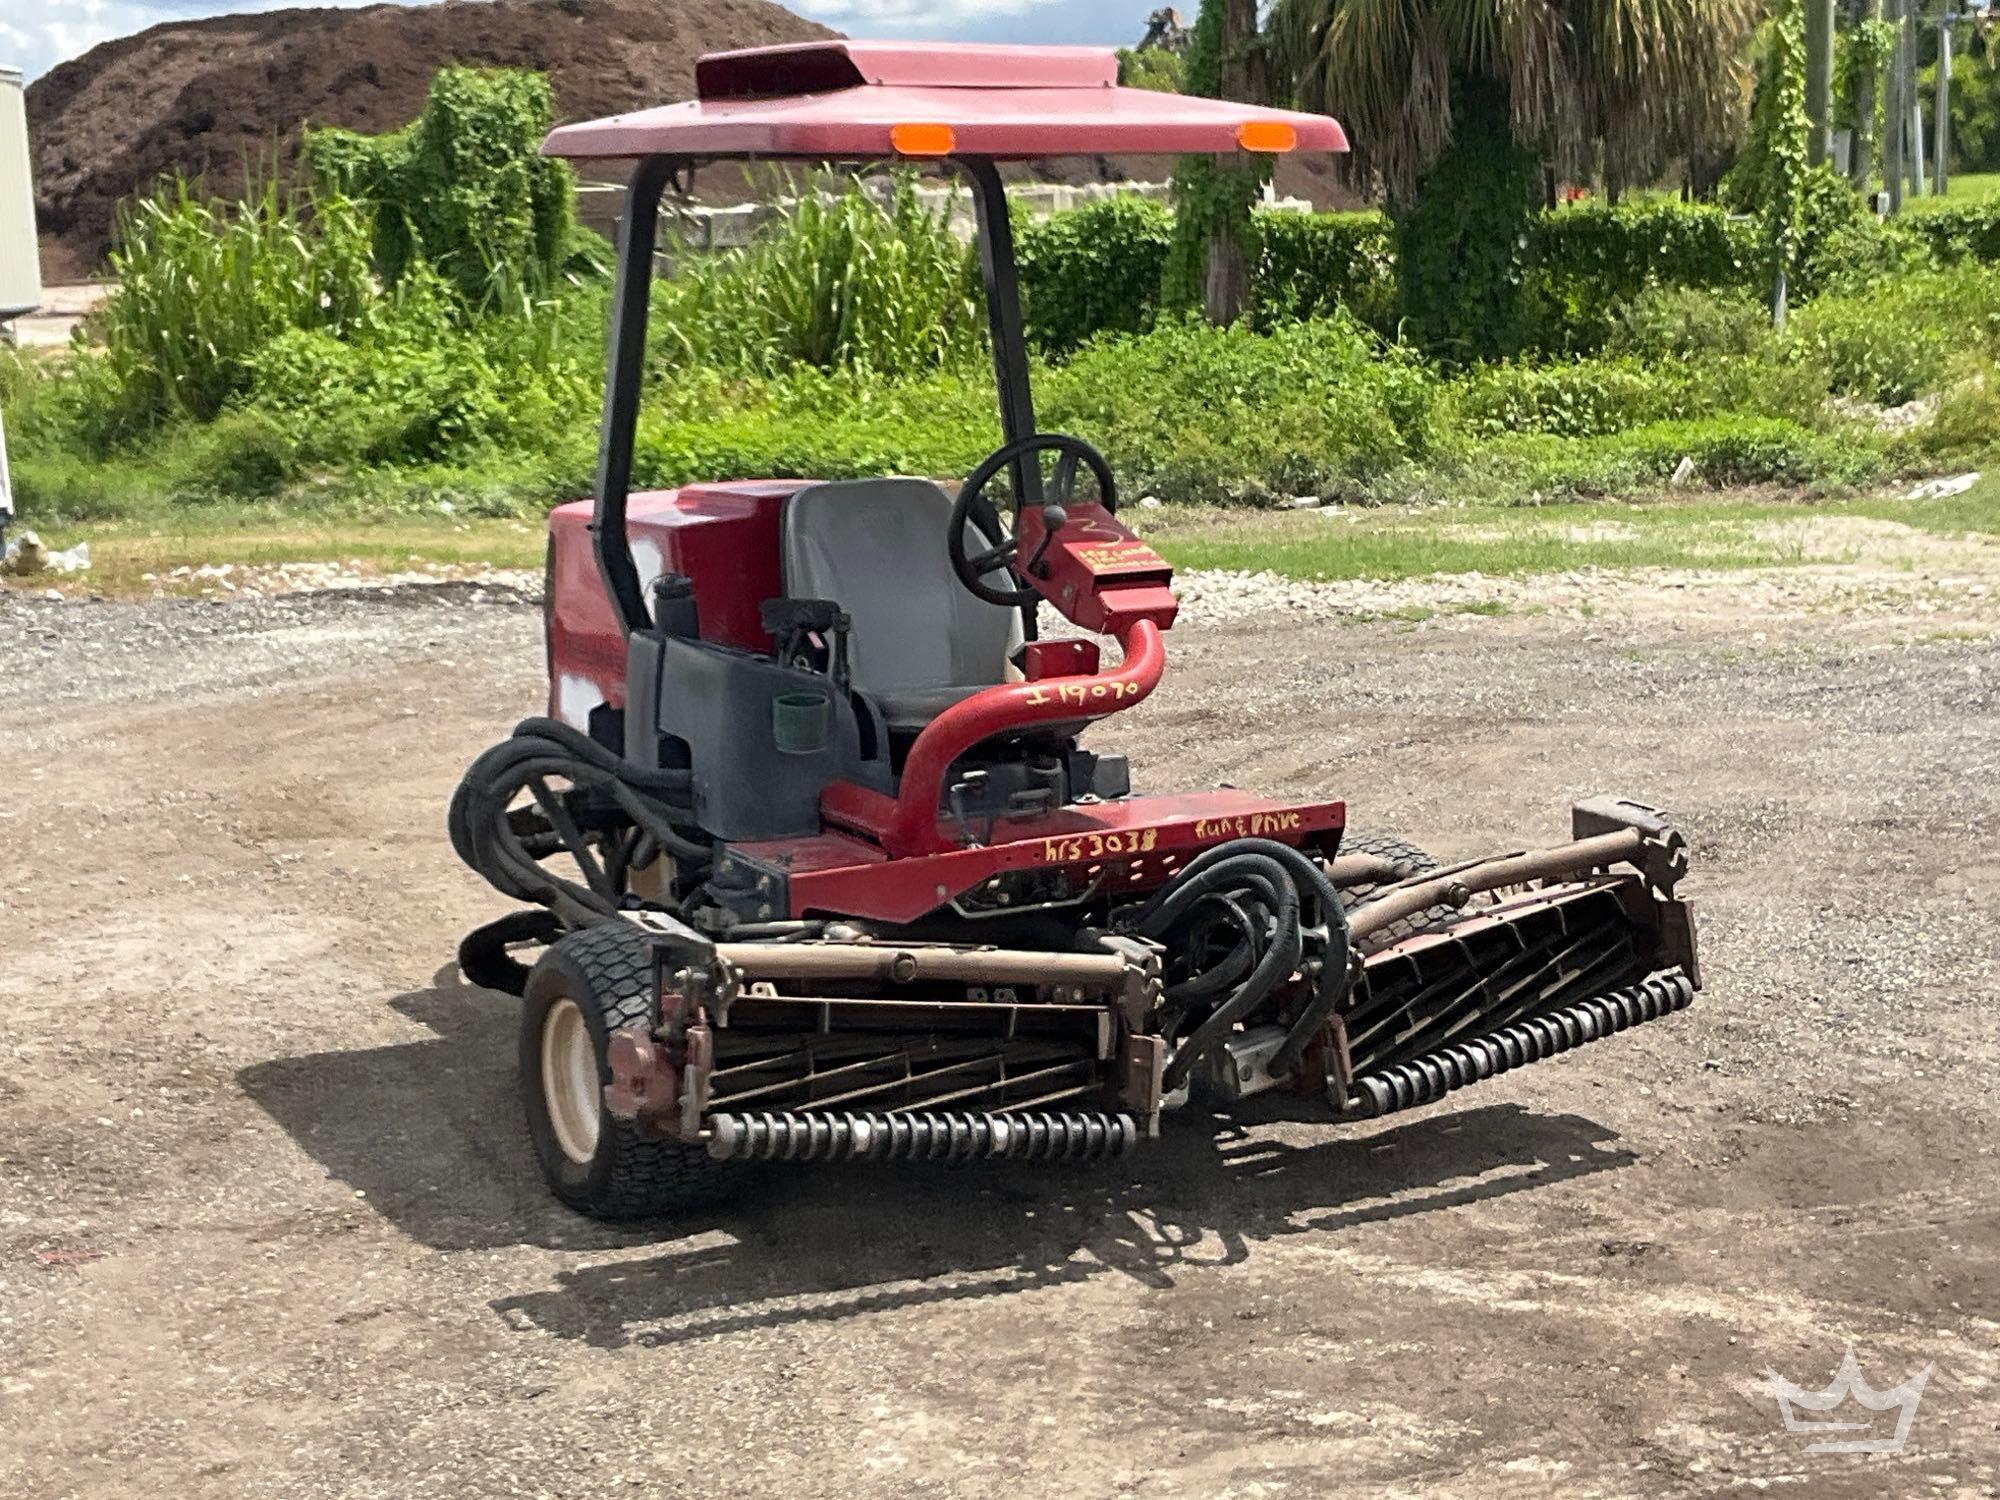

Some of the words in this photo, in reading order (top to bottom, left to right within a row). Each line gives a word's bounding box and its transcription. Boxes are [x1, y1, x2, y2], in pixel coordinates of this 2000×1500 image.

[1058, 682, 1138, 706] 19070
[1045, 838, 1083, 861] hrs
[1088, 828, 1157, 857] 3038
